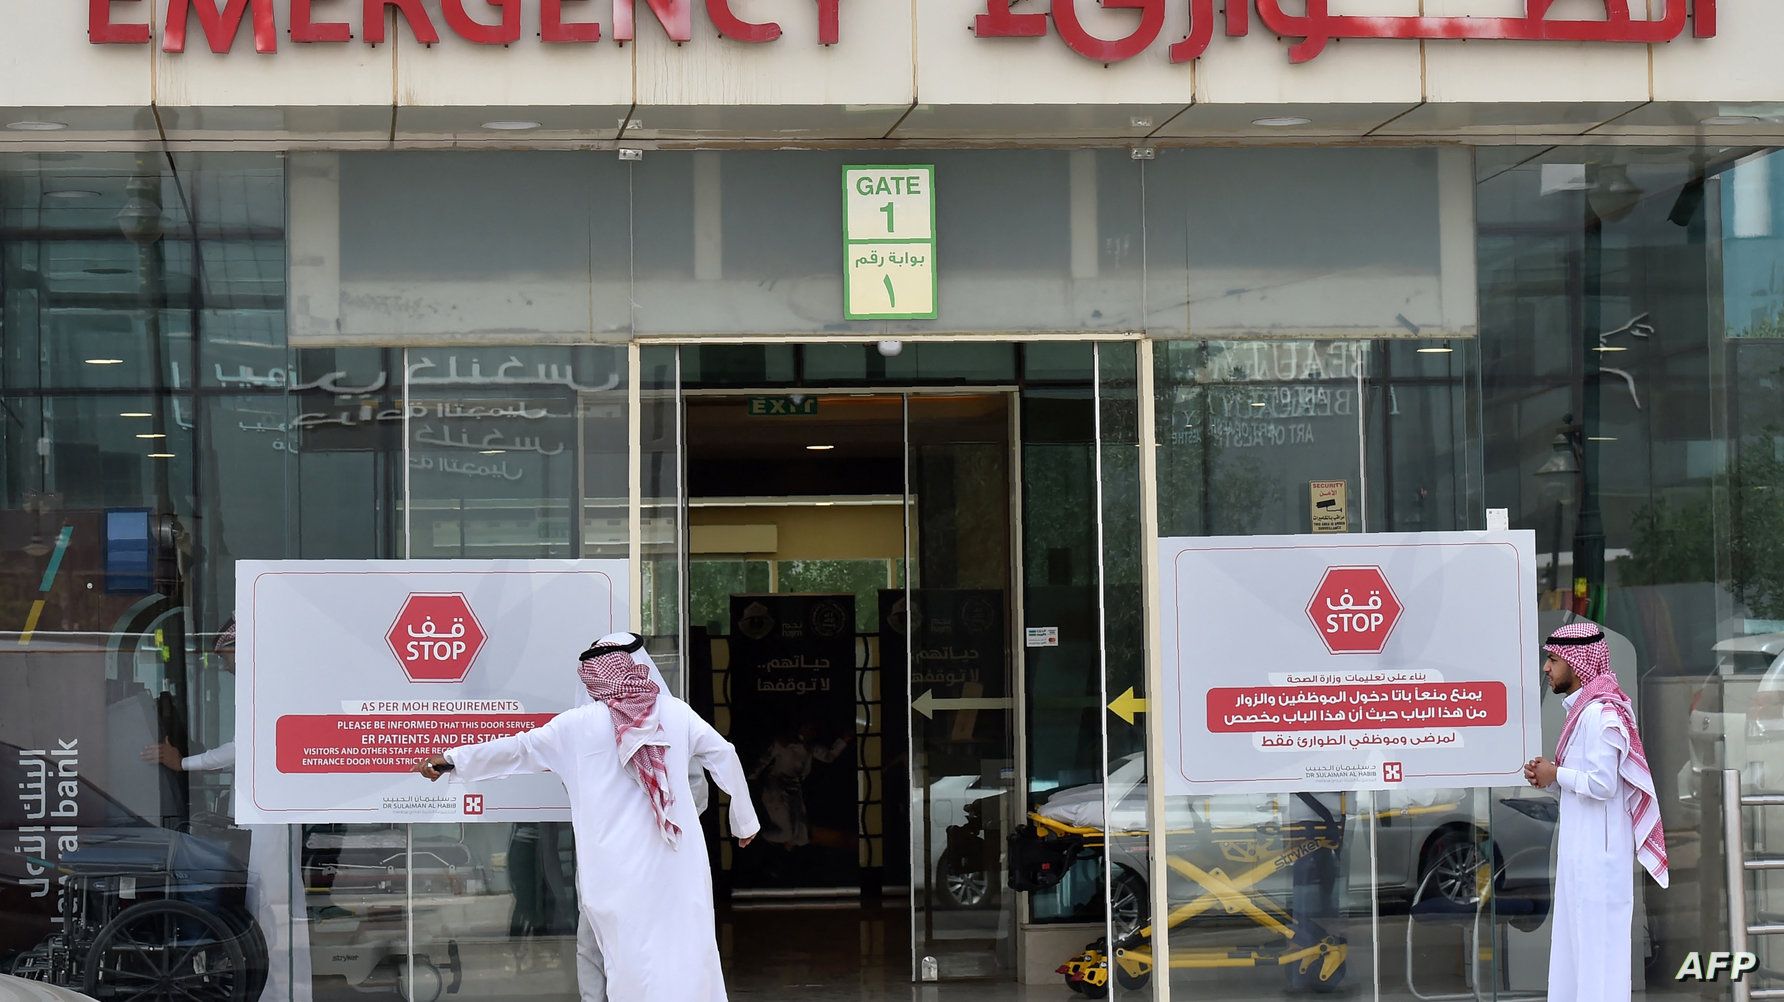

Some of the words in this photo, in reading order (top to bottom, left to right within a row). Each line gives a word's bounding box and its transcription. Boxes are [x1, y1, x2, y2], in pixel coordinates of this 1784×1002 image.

[856, 176, 921, 196] GATE
[879, 201, 895, 233] 1
[855, 250, 885, 268] رقم
[888, 251, 925, 267] بوابة
[883, 273, 896, 308] ١
[1326, 588, 1382, 611] قف
[407, 615, 466, 639] قف
[1326, 614, 1384, 634] STOP
[406, 641, 466, 661] STOP
[1287, 674, 1318, 683] الصحة
[1319, 674, 1341, 684] وزارة
[1345, 673, 1385, 684] تعليمات
[1387, 673, 1406, 682] على
[1410, 672, 1426, 681] بناء
[1235, 693, 1276, 707] والزوار
[1278, 691, 1347, 706] الموظفين
[1349, 690, 1389, 704] دخول
[1450, 688, 1483, 702] يمنع
[361, 702, 376, 712] AS
[379, 702, 399, 712] PER
[402, 702, 429, 711] MOH
[432, 701, 519, 712] REQUIREMENTS
[1438, 706, 1463, 718] هذا
[1466, 706, 1487, 719] من
[1224, 711, 1280, 725] مخصص
[1282, 710, 1317, 724] الباب
[1320, 709, 1346, 721] هذا
[1348, 706, 1363, 722] أن
[1365, 707, 1399, 722] حيث
[1401, 707, 1435, 721] الباب
[337, 721, 372, 730] PLEASE
[374, 721, 386, 729] BE
[387, 720, 438, 729] INFORMED
[439, 721, 460, 729] THAT
[461, 721, 479, 729] THIS
[480, 721, 505, 729] DOOR
[505, 721, 536, 729] SERVES
[361, 734, 376, 744] ER
[378, 734, 430, 744] PATIENTS
[433, 734, 458, 744] AND
[461, 734, 475, 744] ER
[1261, 734, 1294, 747] فقط
[1297, 735, 1346, 748] الطوارئ
[1349, 733, 1407, 750] وموظفي
[1410, 732, 1455, 745] لمرضى
[303, 747, 339, 755] VISITORS
[340, 747, 359, 755] AND
[360, 747, 388, 755] OTHER
[389, 747, 413, 755] STAFF
[302, 758, 345, 766] ENTRANCE
[346, 757, 371, 766] DOOR
[371, 757, 394, 765] YOUR
[395, 757, 423, 765] STRICT
[18, 749, 54, 820] البنك
[50, 738, 78, 817] bank
[14, 825, 50, 898] الأول
[1273, 839, 1321, 871] stryker
